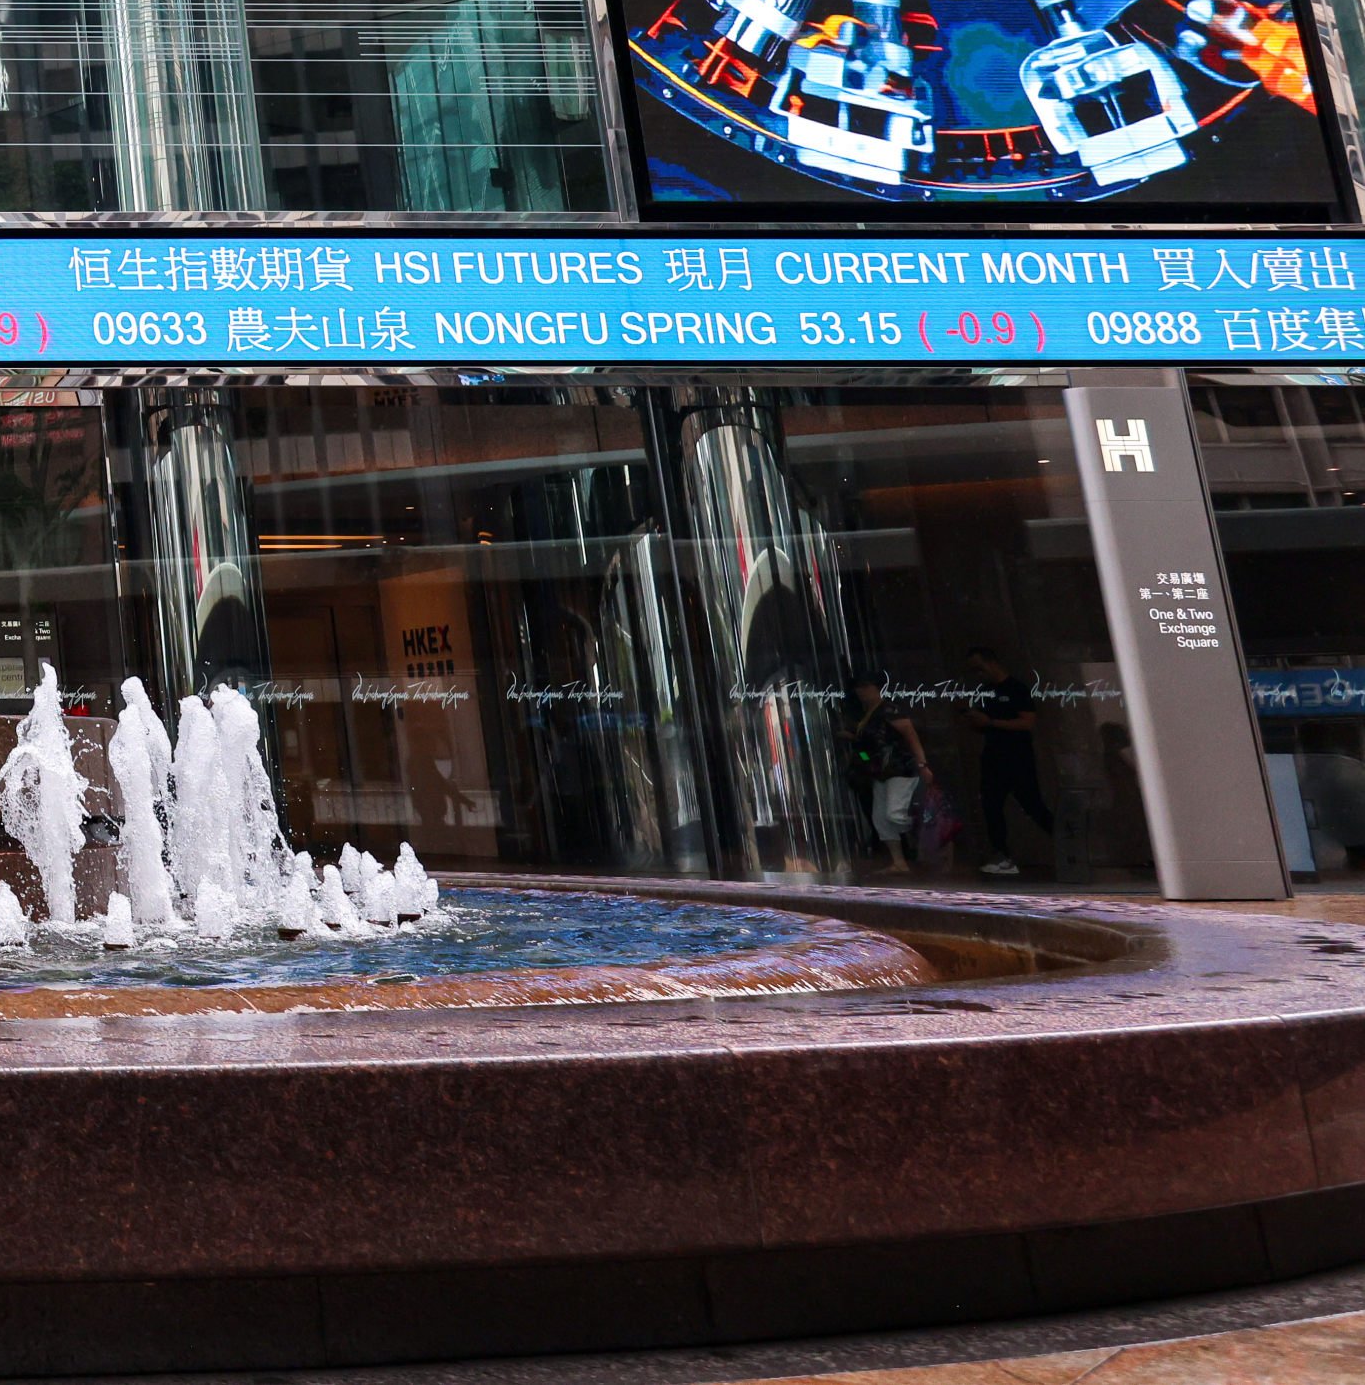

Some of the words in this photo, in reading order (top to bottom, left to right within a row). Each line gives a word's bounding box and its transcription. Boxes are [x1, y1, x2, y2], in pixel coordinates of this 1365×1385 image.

[67, 246, 355, 293] 恒生指數期貨
[374, 251, 442, 286] HSI
[453, 251, 644, 286] FUTURES
[663, 246, 755, 292] 現月
[774, 250, 971, 286] CURRENT
[982, 251, 1131, 286] MONTH
[92, 311, 208, 347] 09633
[225, 307, 417, 354] 農夫山泉
[434, 311, 611, 346] NONGFU
[619, 311, 775, 346] SPRING
[799, 311, 903, 345] 53.15
[1086, 311, 1203, 346] 09888
[1213, 306, 1365, 352] 百度集
[1149, 608, 1175, 621] One
[1176, 608, 1188, 621] &
[1187, 608, 1214, 621] Two
[402, 624, 452, 657] HKEX
[1158, 622, 1217, 636] Exchange
[1176, 636, 1219, 650] Square
